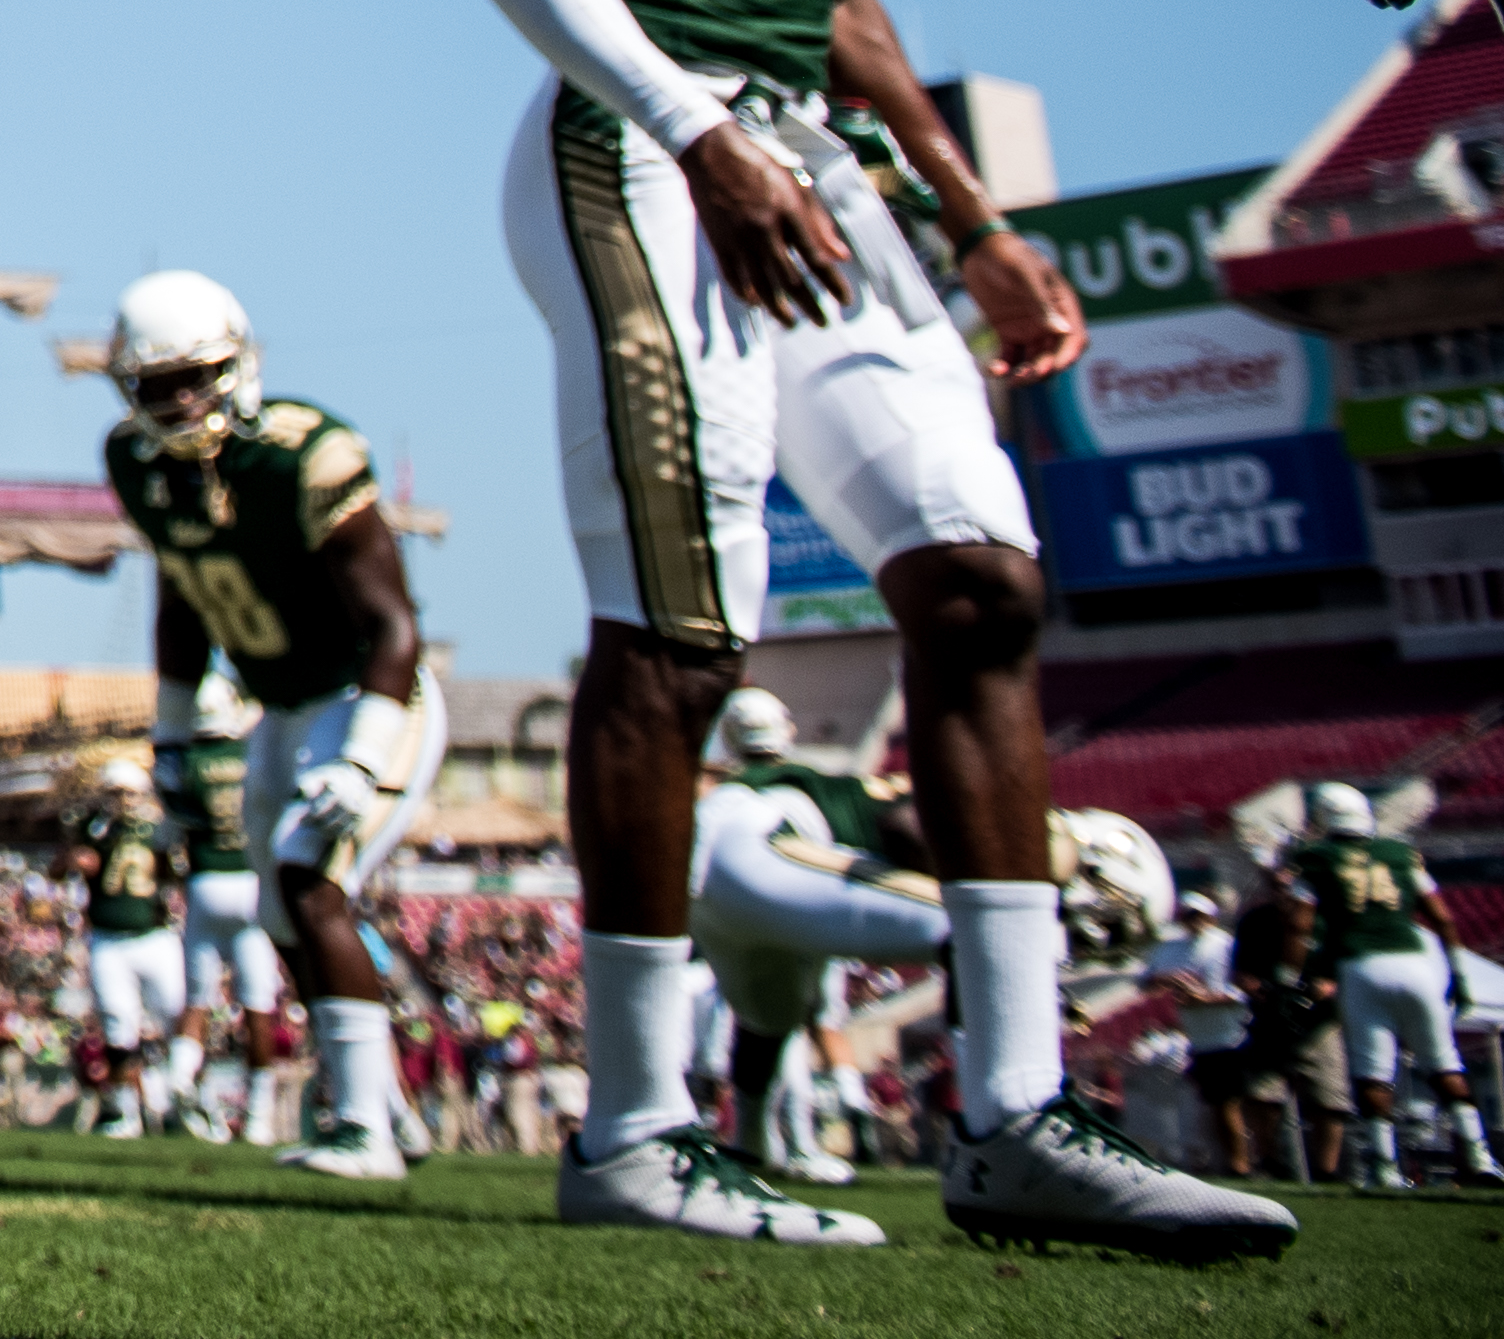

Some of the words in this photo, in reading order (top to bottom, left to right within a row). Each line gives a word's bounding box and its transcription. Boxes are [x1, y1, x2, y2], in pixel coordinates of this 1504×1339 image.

[1090, 350, 1285, 409] Frontier
[1129, 454, 1274, 517] BUD
[1111, 497, 1306, 567] LIGHT
